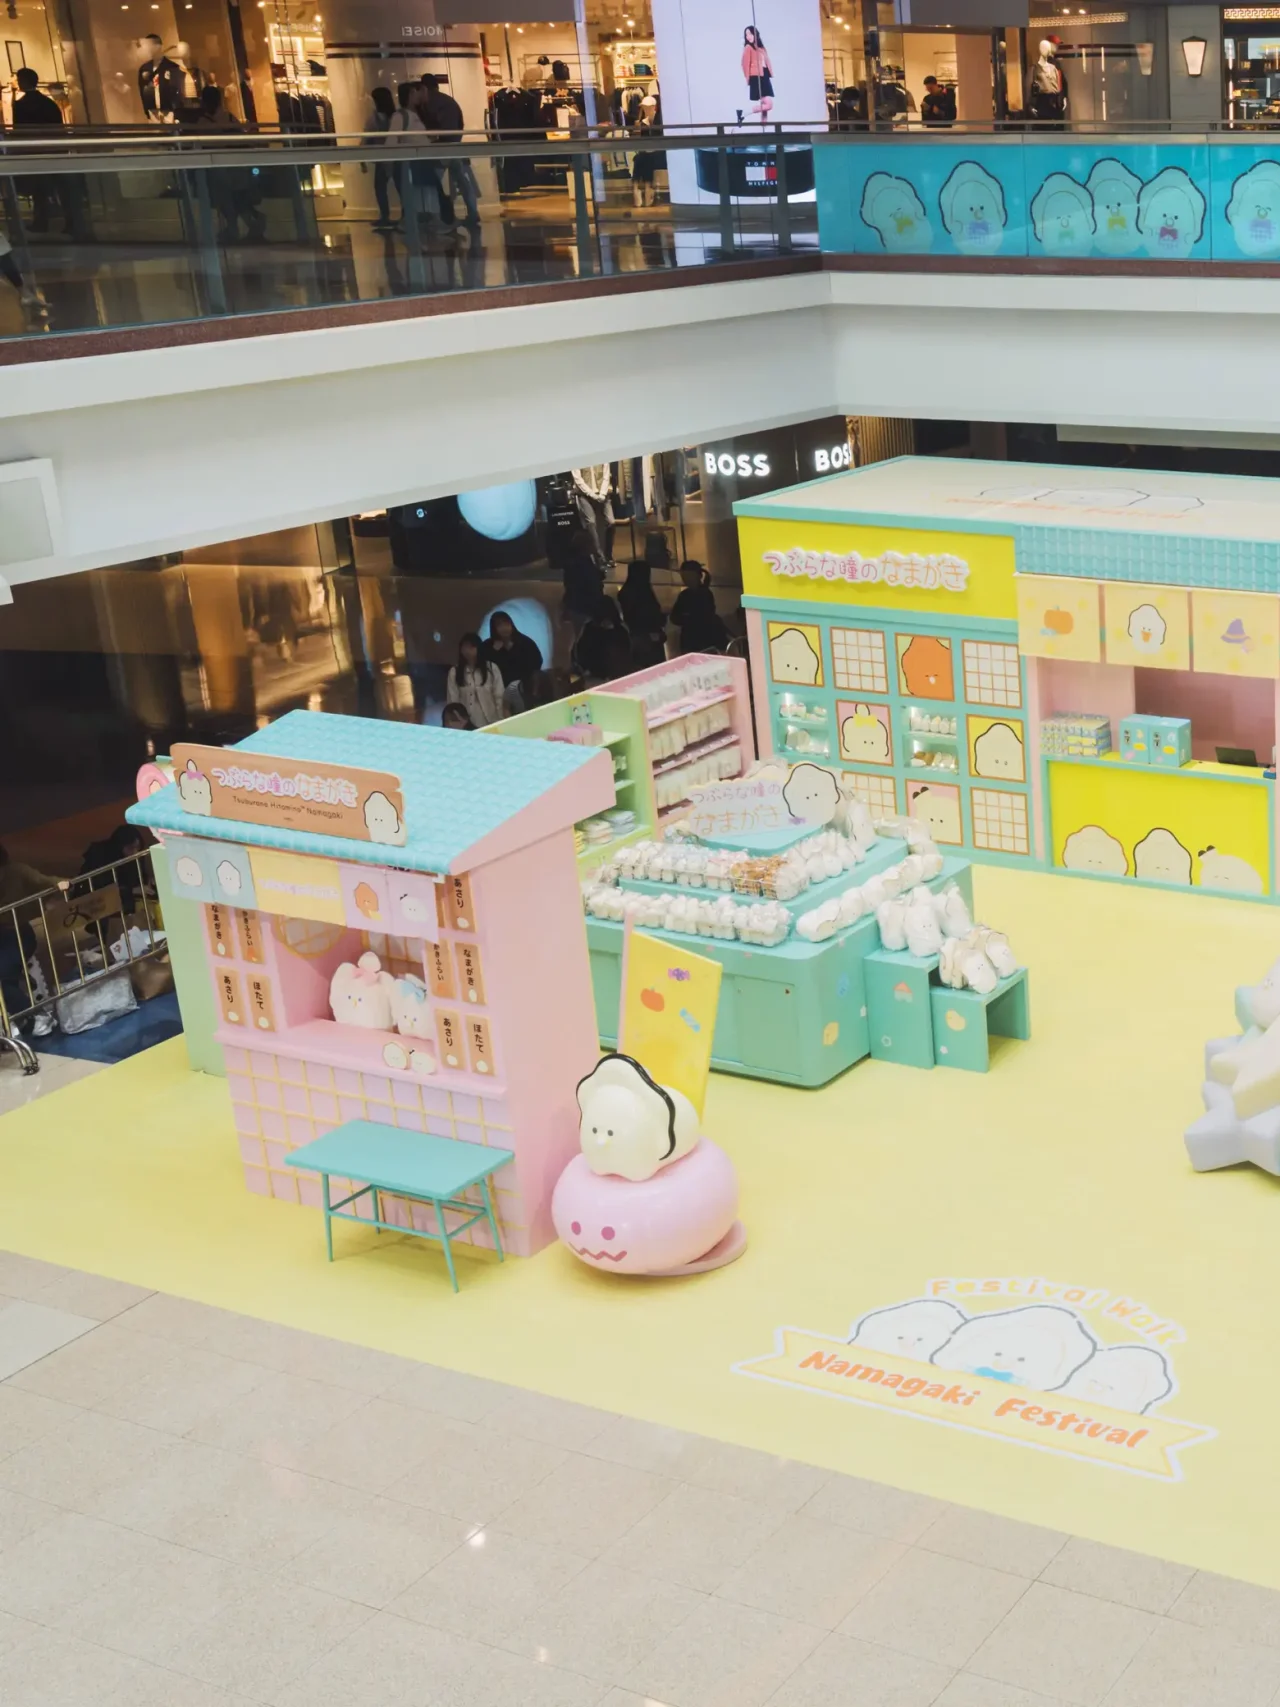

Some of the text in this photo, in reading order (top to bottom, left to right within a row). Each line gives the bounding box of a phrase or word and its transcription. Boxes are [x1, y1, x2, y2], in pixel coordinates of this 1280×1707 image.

[705, 452, 771, 476] BOSS
[815, 443, 852, 472] BOS
[764, 551, 965, 589] つぶらな瞳のなまがき
[211, 768, 357, 806] つぶらな瞳のなまがき
[691, 781, 781, 803] つぶらな瞳の
[694, 804, 782, 835] なまがき
[454, 878, 464, 908] あさり
[463, 949, 475, 986] なまがき
[223, 975, 234, 1003] あさり
[253, 981, 264, 1010] ほたて
[443, 1017, 453, 1047] あさり
[473, 1023, 484, 1053] ほたて
[931, 1277, 1183, 1344] Festival Walk
[798, 1350, 1150, 1449] Namagaki Festival
